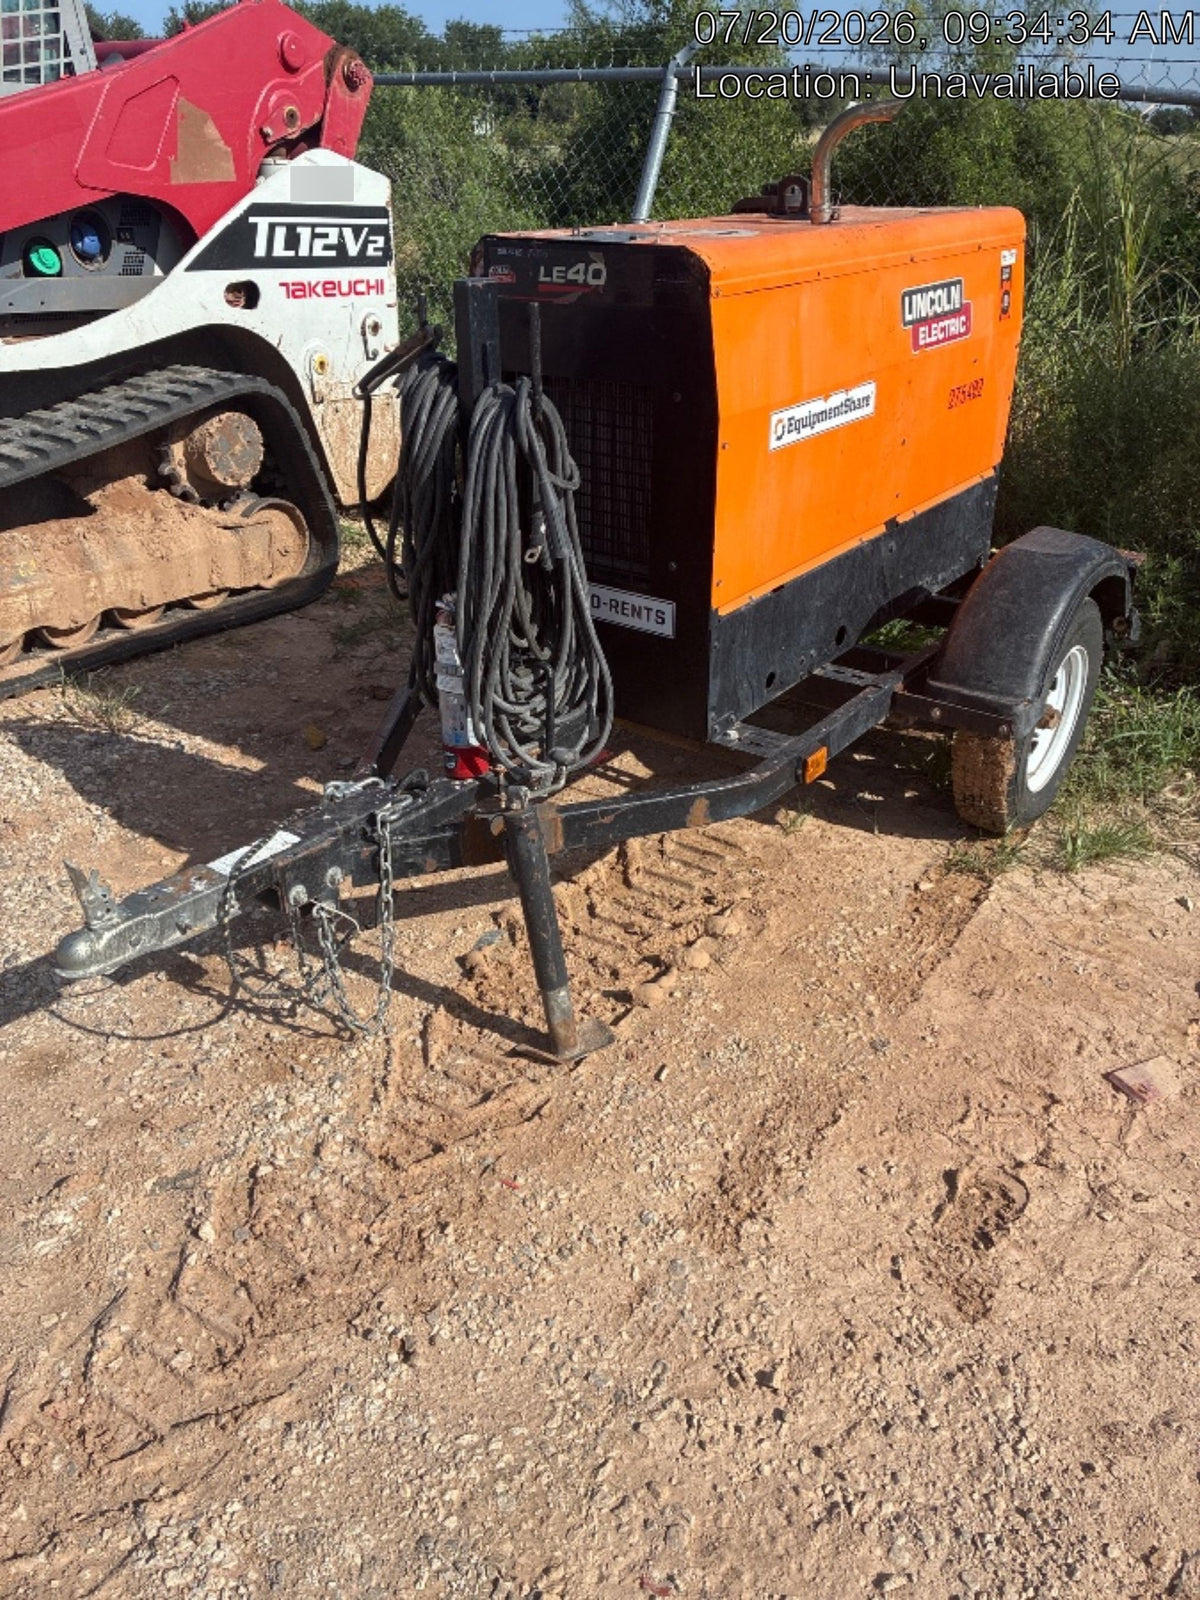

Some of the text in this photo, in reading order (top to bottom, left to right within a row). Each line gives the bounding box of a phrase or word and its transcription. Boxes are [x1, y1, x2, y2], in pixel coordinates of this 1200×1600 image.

[538, 262, 607, 286] LE40
[904, 284, 961, 322] LINCOLN
[918, 315, 967, 346] ELECTRIC
[787, 394, 871, 435] EquipmentShare
